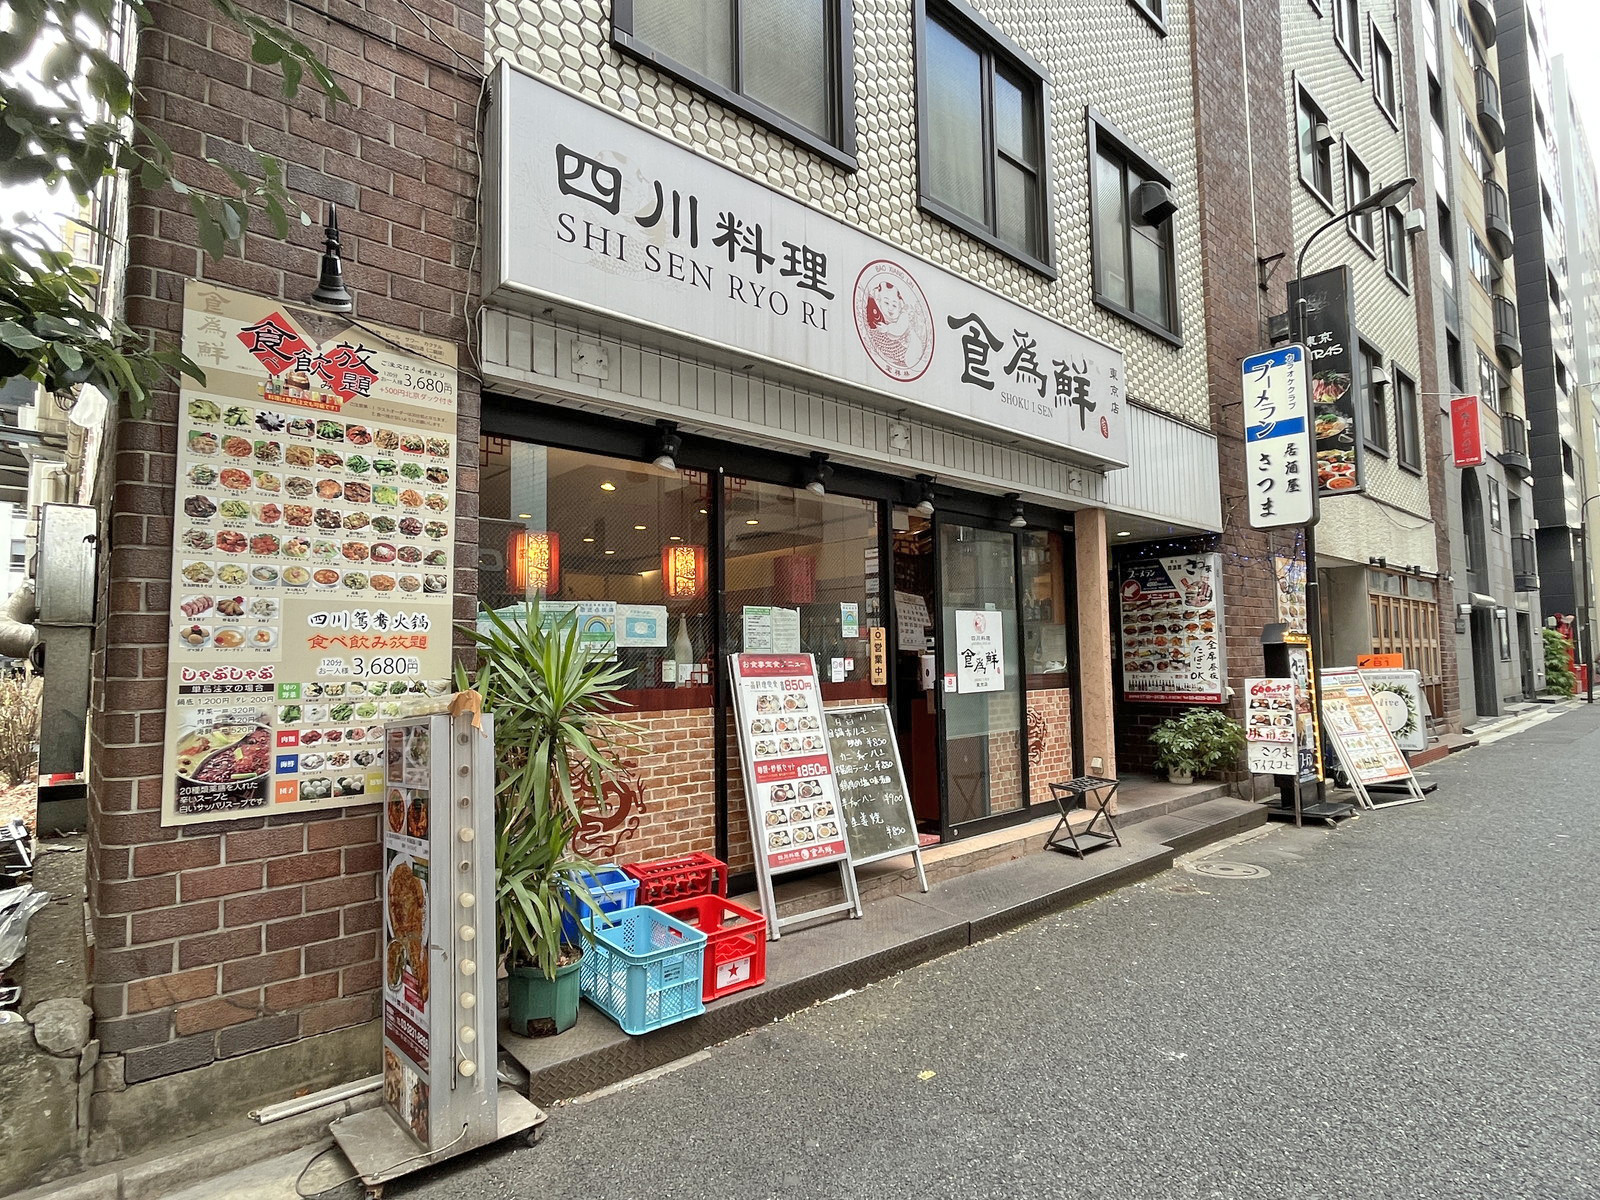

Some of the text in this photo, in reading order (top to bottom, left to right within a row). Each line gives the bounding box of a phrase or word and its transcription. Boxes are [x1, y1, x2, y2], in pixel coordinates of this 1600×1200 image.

[555, 143, 836, 301] 四川料理
[556, 213, 828, 331] SHI SEN RYO RI
[1306, 331, 1333, 348] 東京
[1109, 367, 1120, 415] 東京店
[1285, 353, 1296, 410] カラオケクラブ
[1000, 391, 1030, 410] SHOKU
[1037, 403, 1053, 418] SEN
[1252, 358, 1278, 439] ブーメラン
[1284, 442, 1301, 494] 居酒屋
[1257, 453, 1278, 518] さつま
[308, 634, 428, 650] 食べ飲み放題
[353, 657, 419, 678] 3,680円
[874, 642, 882, 677] 営業中
[182, 666, 274, 681] しゃぶしゃぶ
[318, 667, 349, 675] お一人様
[1191, 671, 1206, 681] OK
[191, 684, 265, 693] 単品注文の場合
[1261, 747, 1292, 759] さつま
[801, 763, 828, 776] 850円
[180, 793, 228, 804] 辛いスープと
[884, 792, 904, 806] ¥900
